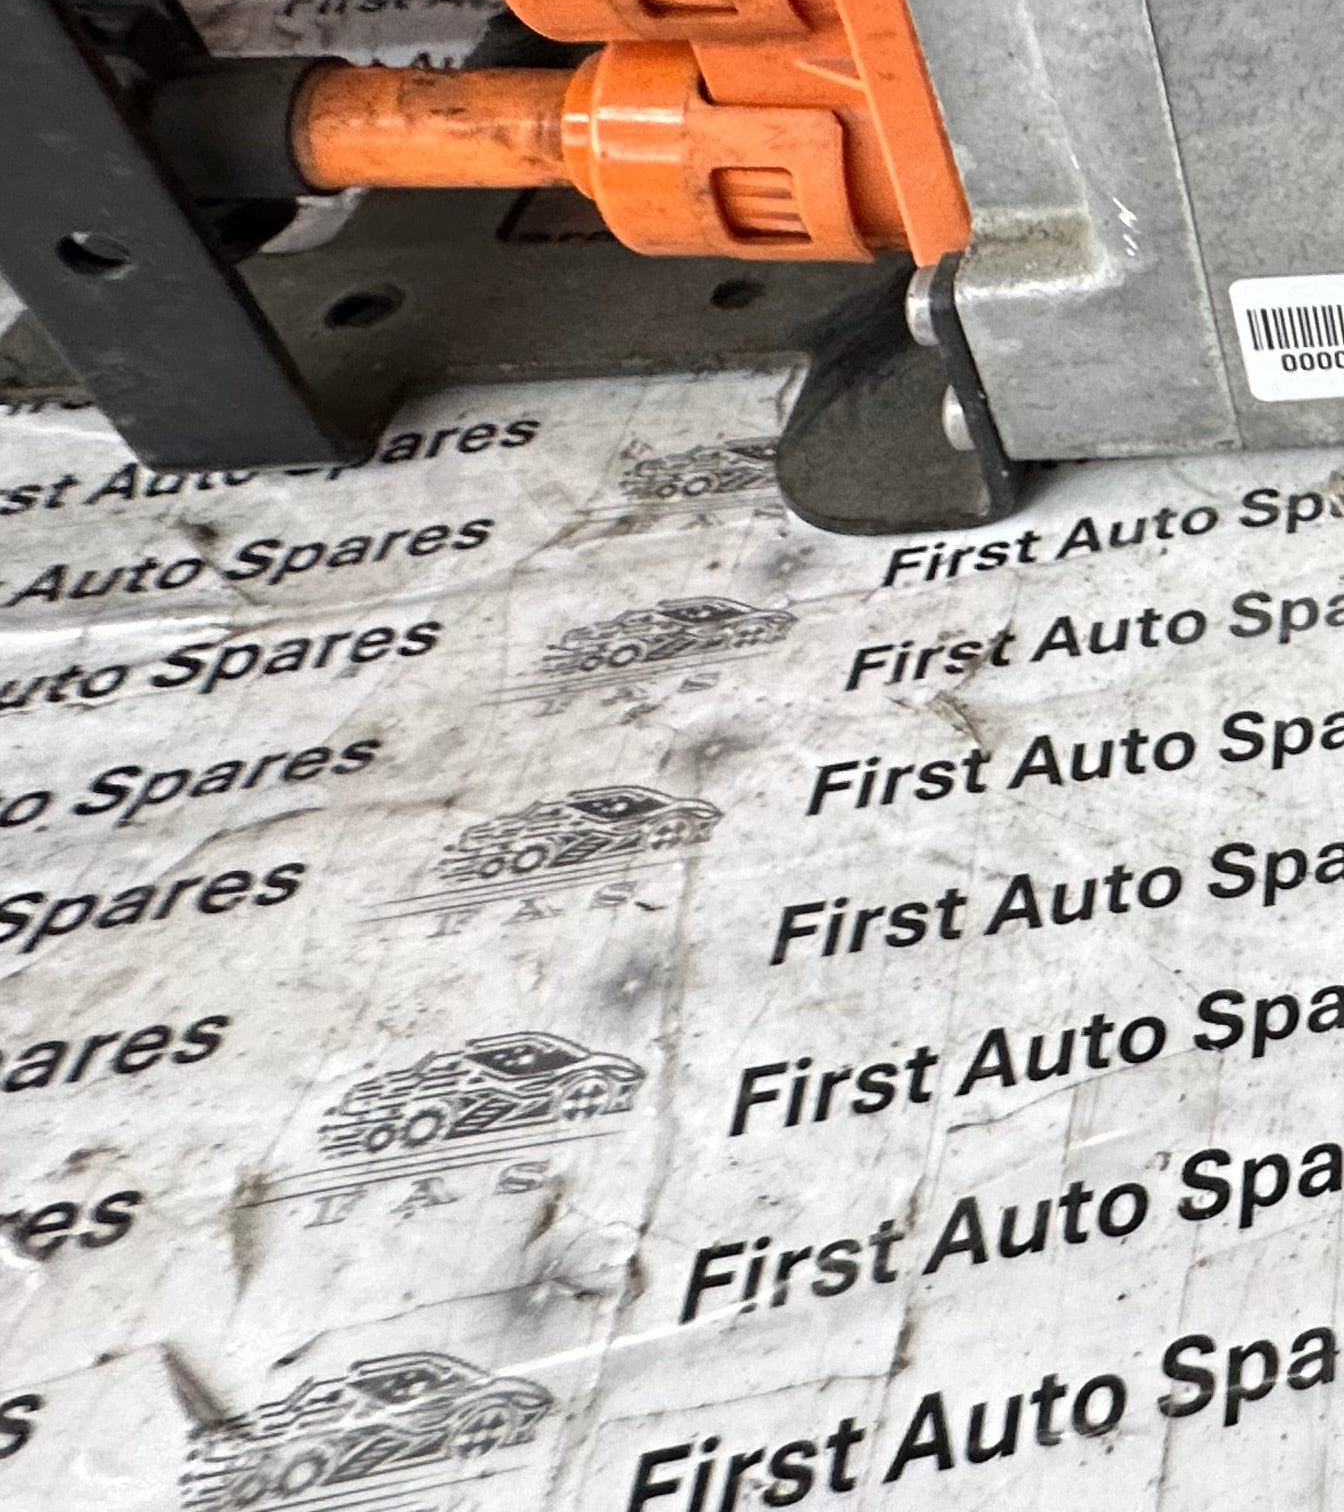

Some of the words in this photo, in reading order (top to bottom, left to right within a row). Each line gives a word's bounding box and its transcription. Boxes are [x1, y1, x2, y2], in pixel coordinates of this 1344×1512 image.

[2, 557, 204, 606] Auto
[223, 515, 496, 585] Spares
[883, 529, 1040, 588] First
[1055, 502, 1219, 558] Auto
[150, 618, 442, 693] Spares
[845, 629, 1016, 691] First
[1032, 604, 1207, 663] Auto
[71, 736, 382, 828] Spares
[805, 749, 990, 816] First
[1007, 726, 1196, 789] Auto
[0, 860, 307, 954] Spares
[769, 885, 967, 966] First
[984, 864, 1182, 936] Auto
[730, 1045, 939, 1137] First
[954, 1014, 1166, 1097] Auto
[680, 1219, 903, 1325] First
[922, 1180, 1148, 1274] Auto
[625, 1417, 868, 1512] First
[883, 1372, 1129, 1484] Auto
